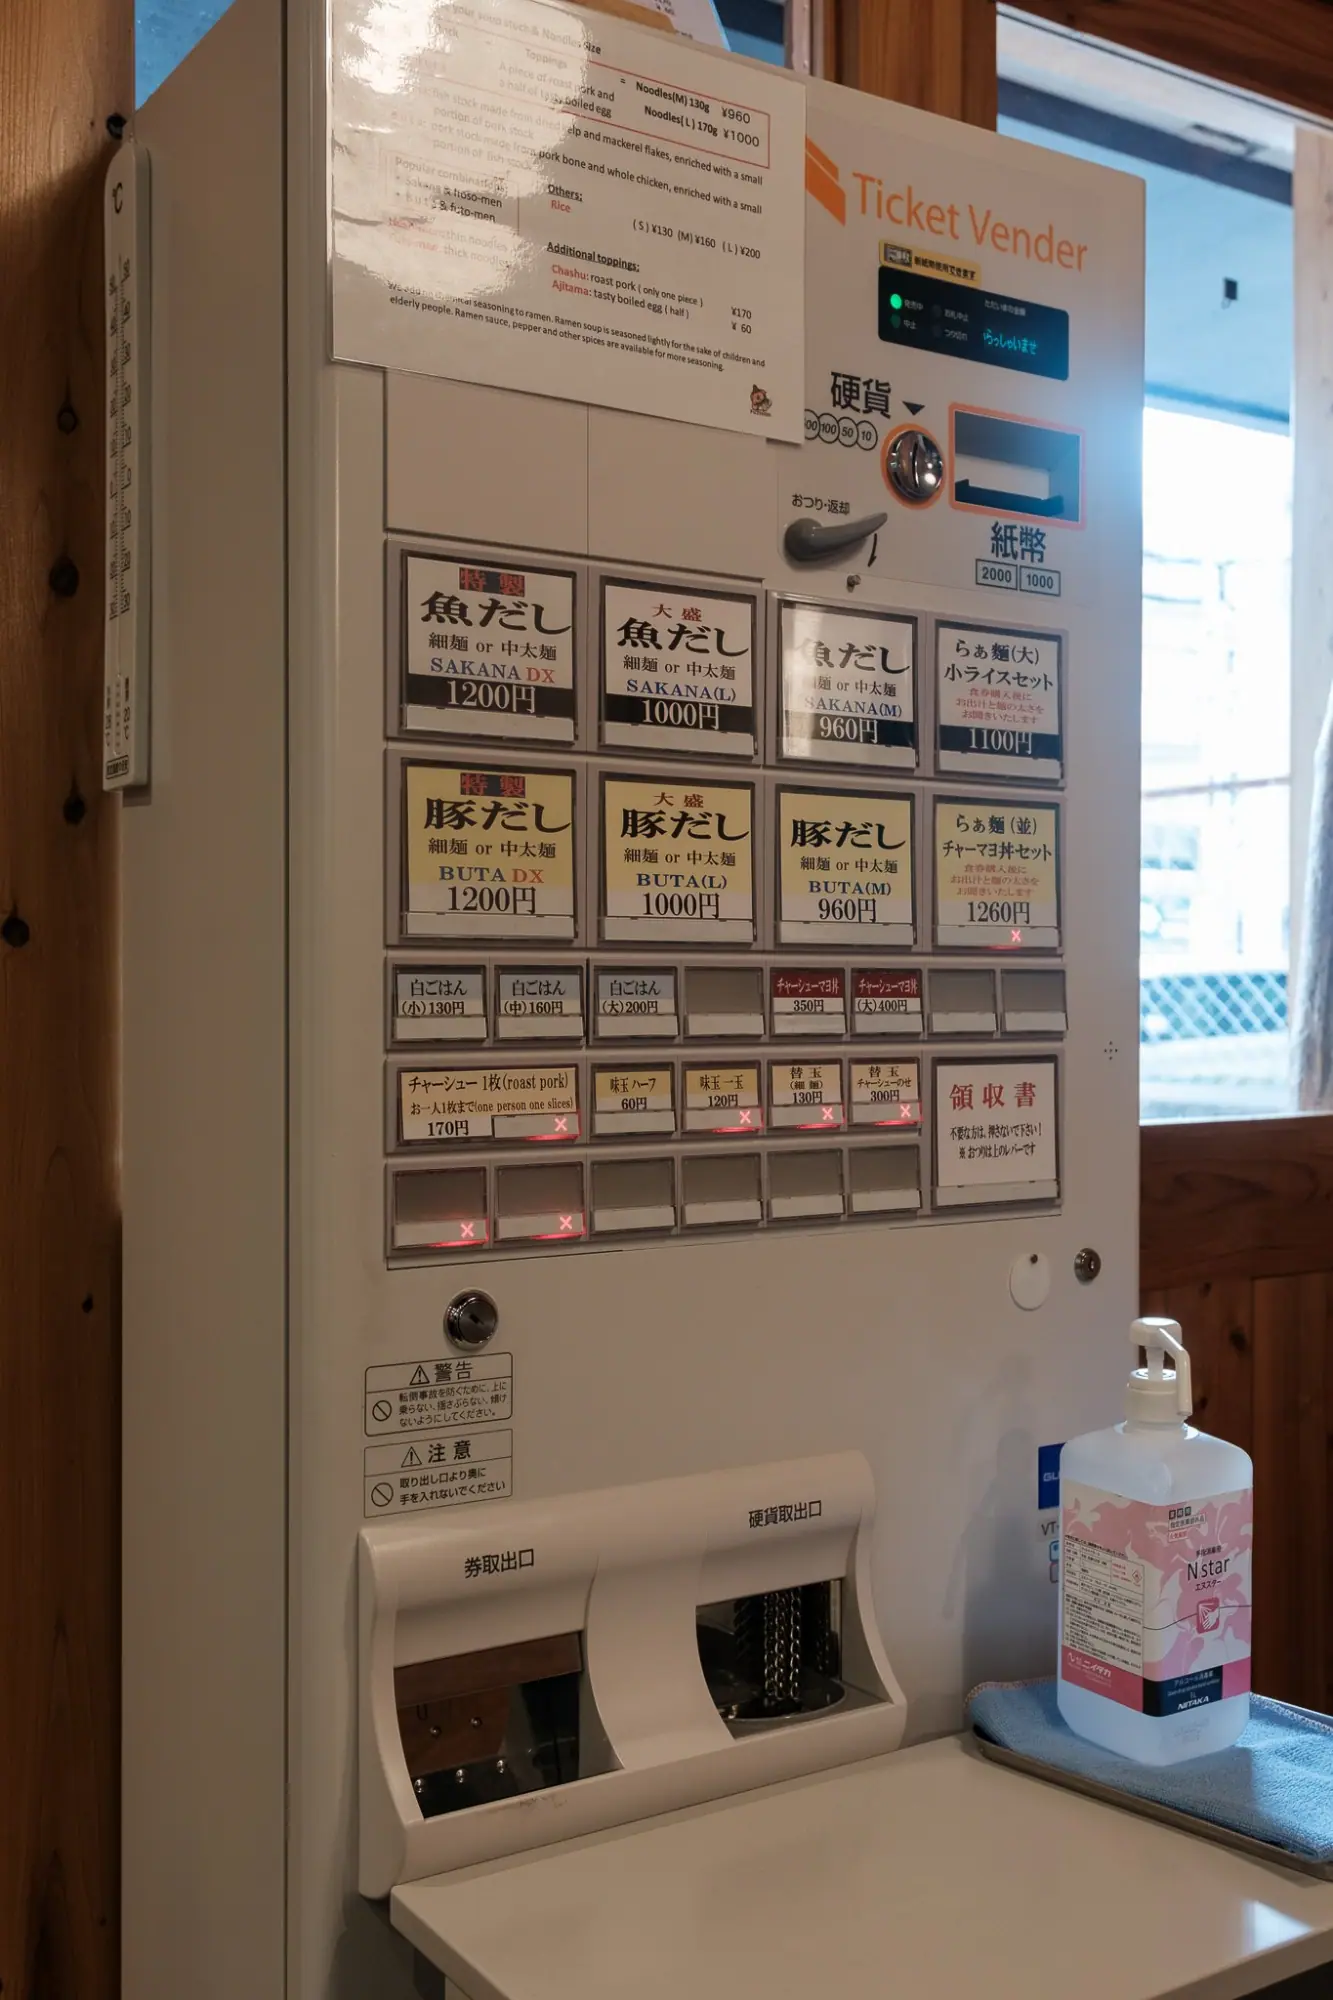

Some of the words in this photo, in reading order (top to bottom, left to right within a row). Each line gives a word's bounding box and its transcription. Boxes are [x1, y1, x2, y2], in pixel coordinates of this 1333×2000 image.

[583, 41, 601, 55] Size
[565, 94, 594, 112] boiled
[596, 105, 612, 119] egg
[597, 88, 615, 101] and
[690, 97, 710, 114] 130g
[722, 107, 751, 124] ¥960
[698, 122, 718, 138] 170g
[723, 128, 760, 148] ¥1000
[584, 128, 600, 142] and
[602, 134, 643, 154] mackerel
[644, 144, 672, 163] flakes,
[674, 156, 712, 173] enriched
[712, 163, 732, 178] with
[740, 172, 763, 186] small
[539, 150, 560, 164] pork
[562, 155, 586, 169] bone
[588, 161, 604, 174] and
[607, 166, 635, 182] whole
[636, 174, 672, 193] chicken,
[674, 184, 710, 202] enriched
[712, 193, 732, 207] with
[740, 202, 762, 214] small
[551, 200, 571, 213] Rice
[852, 172, 960, 240] Ticket
[968, 204, 1089, 272] Vender
[547, 242, 596, 262] Additional
[652, 223, 673, 238] ¥130
[695, 235, 716, 248] ¥160
[740, 246, 760, 260] ¥200
[552, 264, 589, 281] Chashu:
[590, 273, 613, 287] roast
[616, 279, 636, 293] pork
[661, 290, 676, 300] one
[552, 280, 592, 297] Ajitama:
[594, 289, 616, 304] tasty
[618, 294, 646, 308] boiled
[647, 302, 662, 314] egg
[731, 306, 752, 320] ¥170
[390, 296, 420, 310] elderly
[422, 302, 454, 316] people.
[456, 309, 484, 321] Ramen
[485, 315, 511, 328] sauce,
[512, 320, 541, 333] pepper
[542, 326, 558, 336] and
[558, 329, 580, 341] other
[582, 334, 605, 346] spices
[606, 340, 619, 349] are
[620, 342, 654, 356] available
[655, 348, 666, 358] for
[666, 352, 686, 362] more
[687, 355, 725, 372] seasoning.
[473, 299, 514, 316] seasoning
[526, 312, 554, 323] ramen.
[555, 316, 582, 330] Ramen
[584, 322, 602, 334] soup
[611, 328, 646, 342] seasoned
[648, 335, 670, 349] lightly
[672, 340, 682, 350] for
[683, 342, 695, 352] the
[696, 345, 712, 356] sake
[722, 351, 750, 365] children
[752, 358, 766, 368] and
[831, 372, 892, 420] 硬貨
[822, 424, 837, 434] 100
[842, 427, 854, 438] 50
[862, 431, 872, 441] 10
[990, 522, 1047, 564] 紙幣
[982, 566, 1012, 584] 2000
[1026, 572, 1054, 590] 1000
[420, 590, 572, 635] 魚だし
[428, 632, 468, 652] 細麺
[476, 641, 494, 653] or
[501, 640, 557, 661] 中太麺
[616, 616, 749, 657] 魚だし
[430, 657, 522, 680] SAKANA
[526, 667, 556, 684] DX
[623, 654, 658, 673] 細麺
[664, 663, 680, 674] or
[686, 662, 736, 680] 中太麺
[944, 663, 1054, 691] 小ライスセット
[447, 680, 536, 714] 1200円
[836, 680, 850, 692] or
[855, 680, 897, 697] 中太麺
[642, 700, 720, 730] 1000円
[820, 716, 878, 744] 960円
[968, 727, 1033, 755] 1100円
[424, 798, 572, 833] 豚だし
[620, 808, 750, 841] 豚だし
[790, 819, 906, 850] 豚だし
[428, 838, 468, 855] 細麺
[476, 844, 492, 855] or
[500, 840, 556, 859] 中太麺
[624, 848, 659, 864] 細麺
[665, 853, 680, 864] or
[687, 850, 736, 866] 中太麺
[942, 840, 1052, 862] チャーマヨ丼セット
[438, 866, 506, 883] BUTA
[512, 868, 544, 884] DX
[800, 856, 830, 871] 細麺
[836, 860, 850, 872] or
[854, 858, 898, 874] 中太麺
[448, 886, 536, 914] 1200円
[642, 892, 720, 919] 1000円
[818, 898, 876, 924] 960円
[968, 900, 1030, 924] 1260円
[410, 979, 468, 998] 白ごはん
[512, 979, 566, 997] 白ごはん
[609, 979, 662, 997] 白ごはん
[794, 1000, 824, 1012] 350円
[408, 1076, 478, 1094] チャーシュー
[793, 1090, 822, 1104] 130円
[870, 1088, 900, 1102] 300円
[950, 1082, 1036, 1111] 領収書
[497, 1099, 526, 1113] person
[529, 1100, 545, 1110] one
[621, 1098, 648, 1111] 60円
[708, 1094, 739, 1108] 120円
[428, 1120, 469, 1136] 170円
[434, 1360, 473, 1383] 警告
[428, 1440, 472, 1464] 注意
[400, 1468, 486, 1489] 取り出し口より奥に
[400, 1480, 506, 1506] 手を入れないでください
[748, 1500, 823, 1529] 硬貨取出口
[464, 1549, 534, 1578] 券取出口
